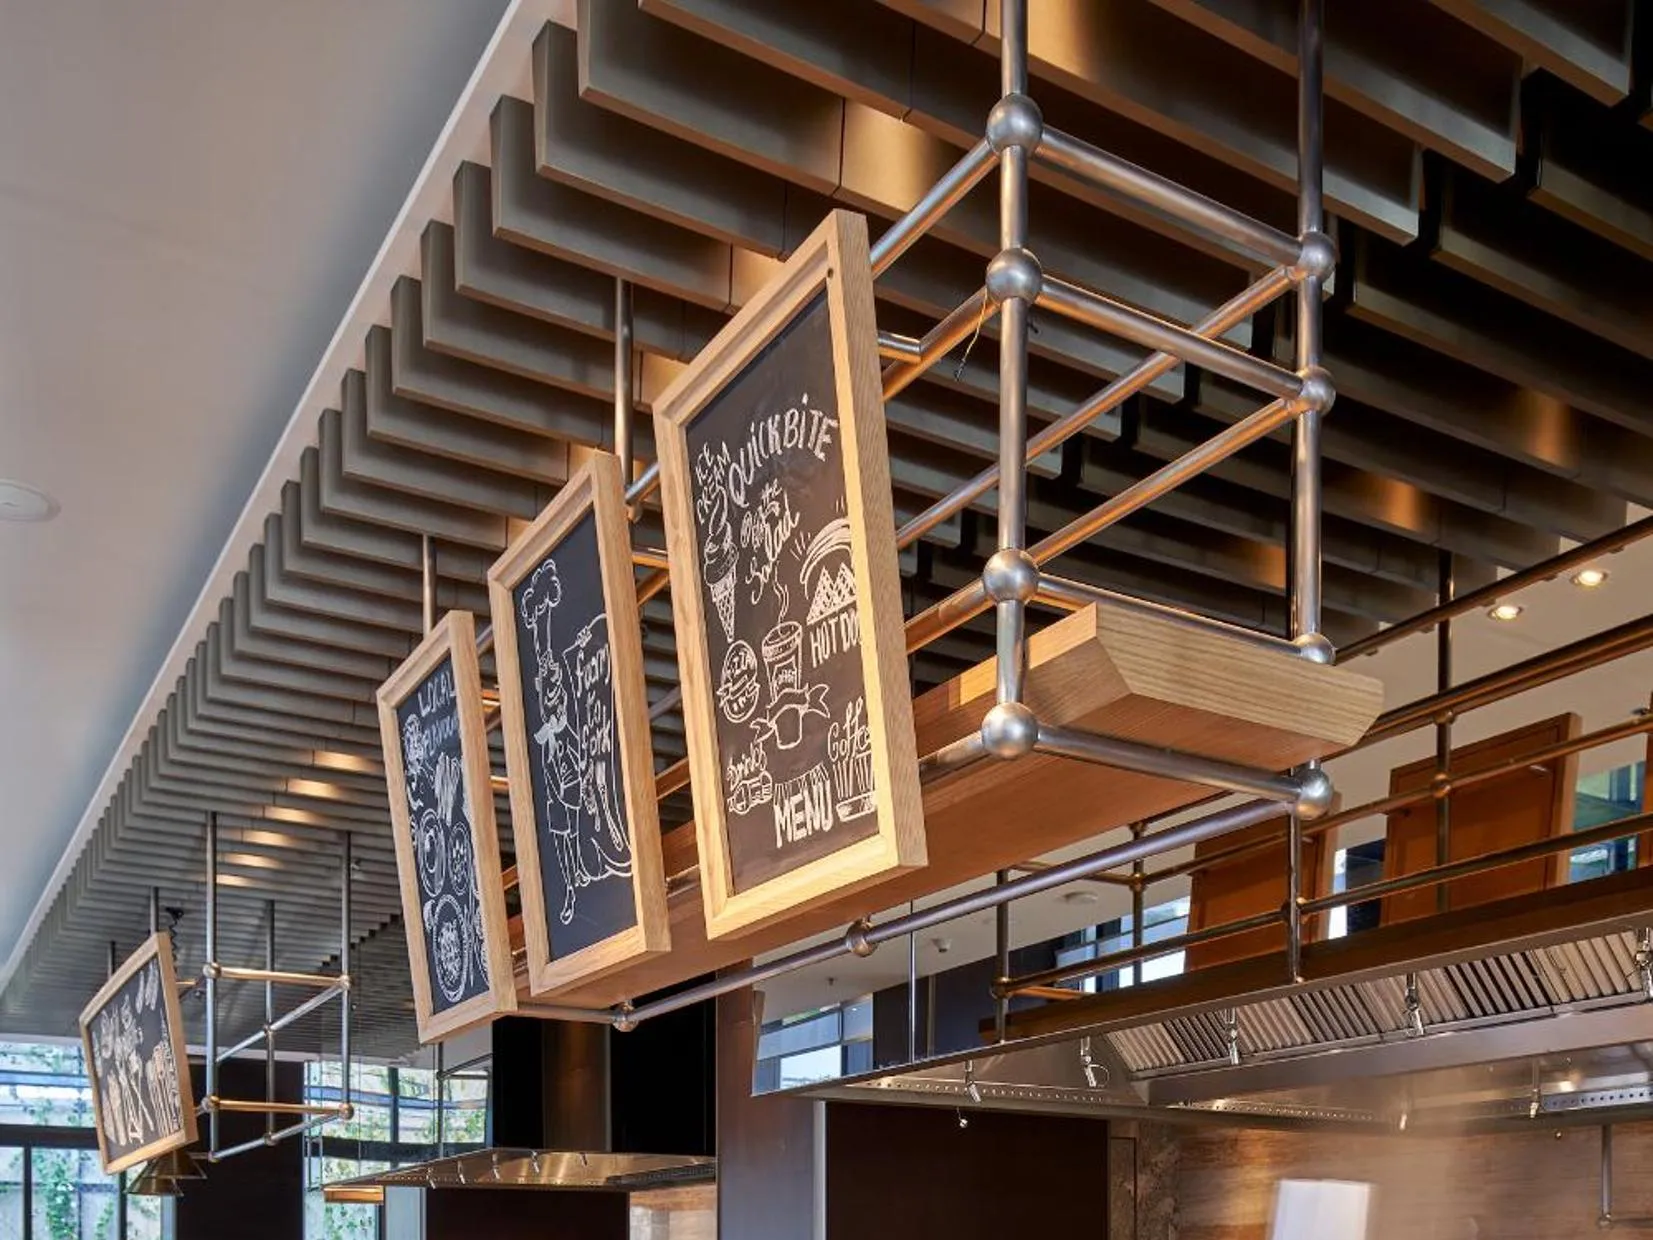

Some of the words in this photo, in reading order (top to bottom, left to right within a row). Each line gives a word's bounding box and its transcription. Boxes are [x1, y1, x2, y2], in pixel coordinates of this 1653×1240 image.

[810, 615, 838, 668] HOT
[839, 607, 862, 652] DO
[773, 779, 833, 848] MENU
